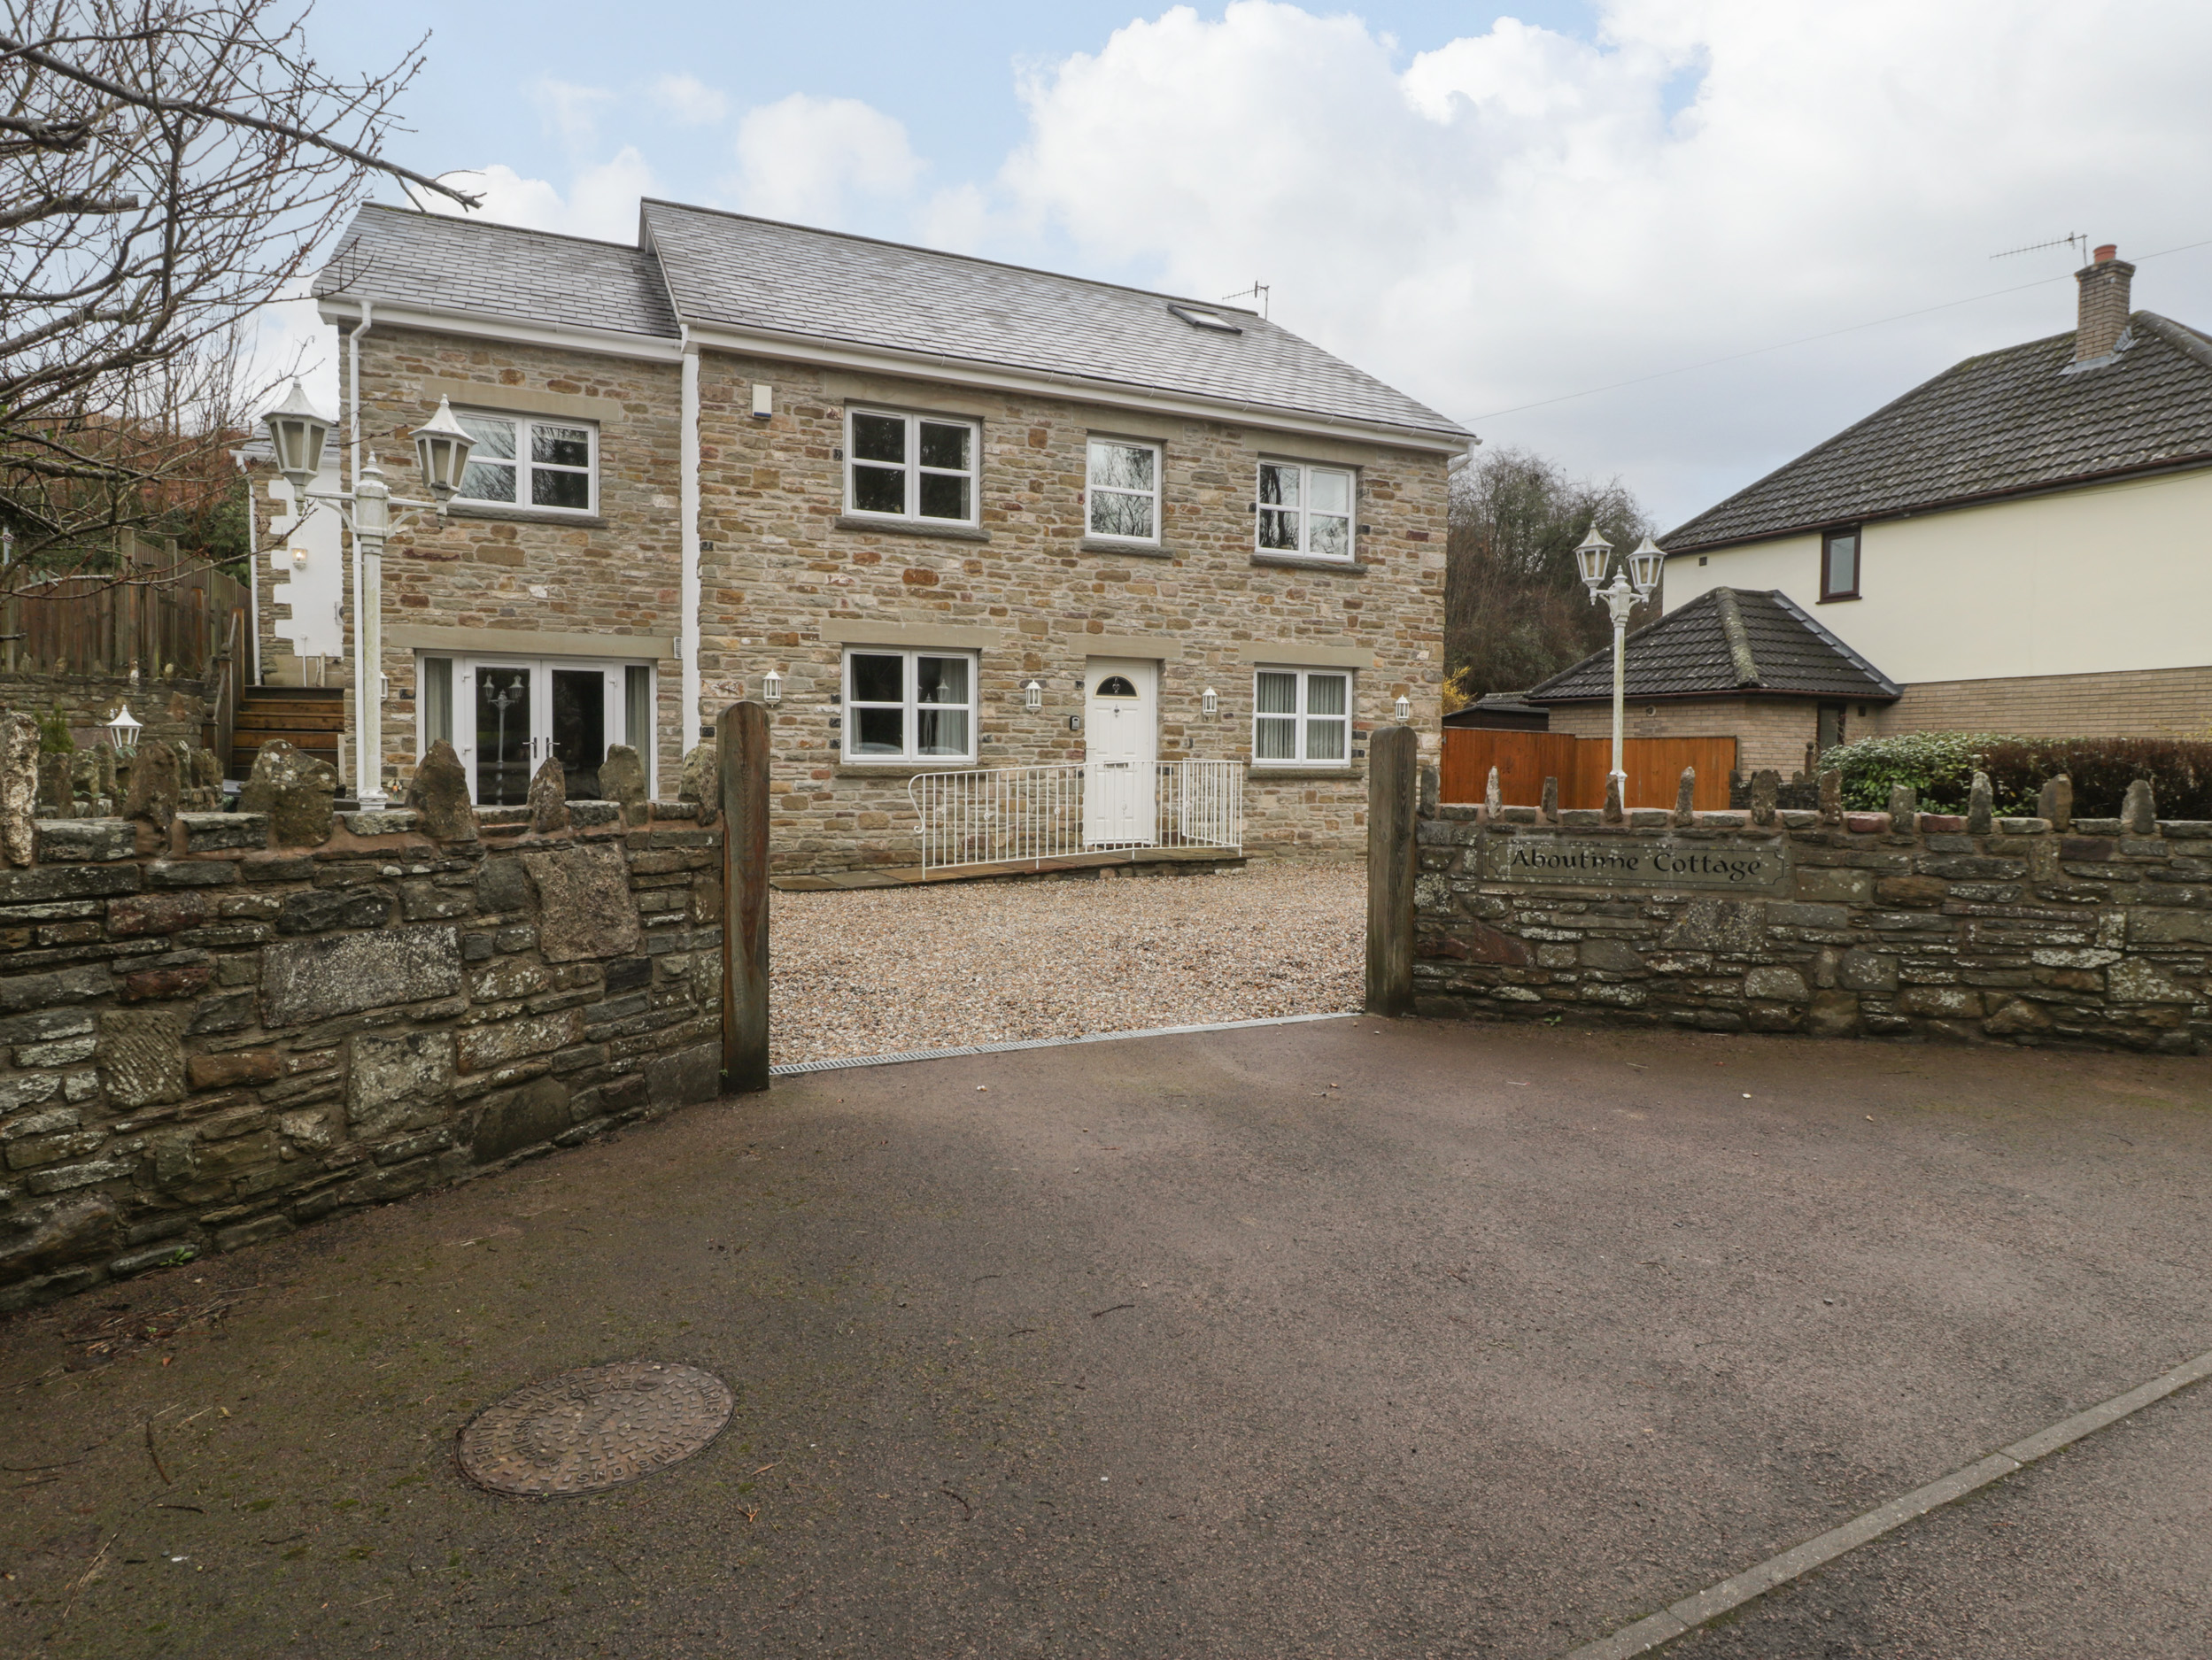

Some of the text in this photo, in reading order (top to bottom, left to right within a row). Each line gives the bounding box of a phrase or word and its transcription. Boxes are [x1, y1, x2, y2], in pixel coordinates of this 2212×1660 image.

[1512, 848, 1761, 882] Aboutime Cottage
[472, 1366, 635, 1470] INSPECTION CHAMBER
[607, 1380, 634, 1391] EN
[576, 1381, 721, 1483] MARLEY EXTRUSIONS
